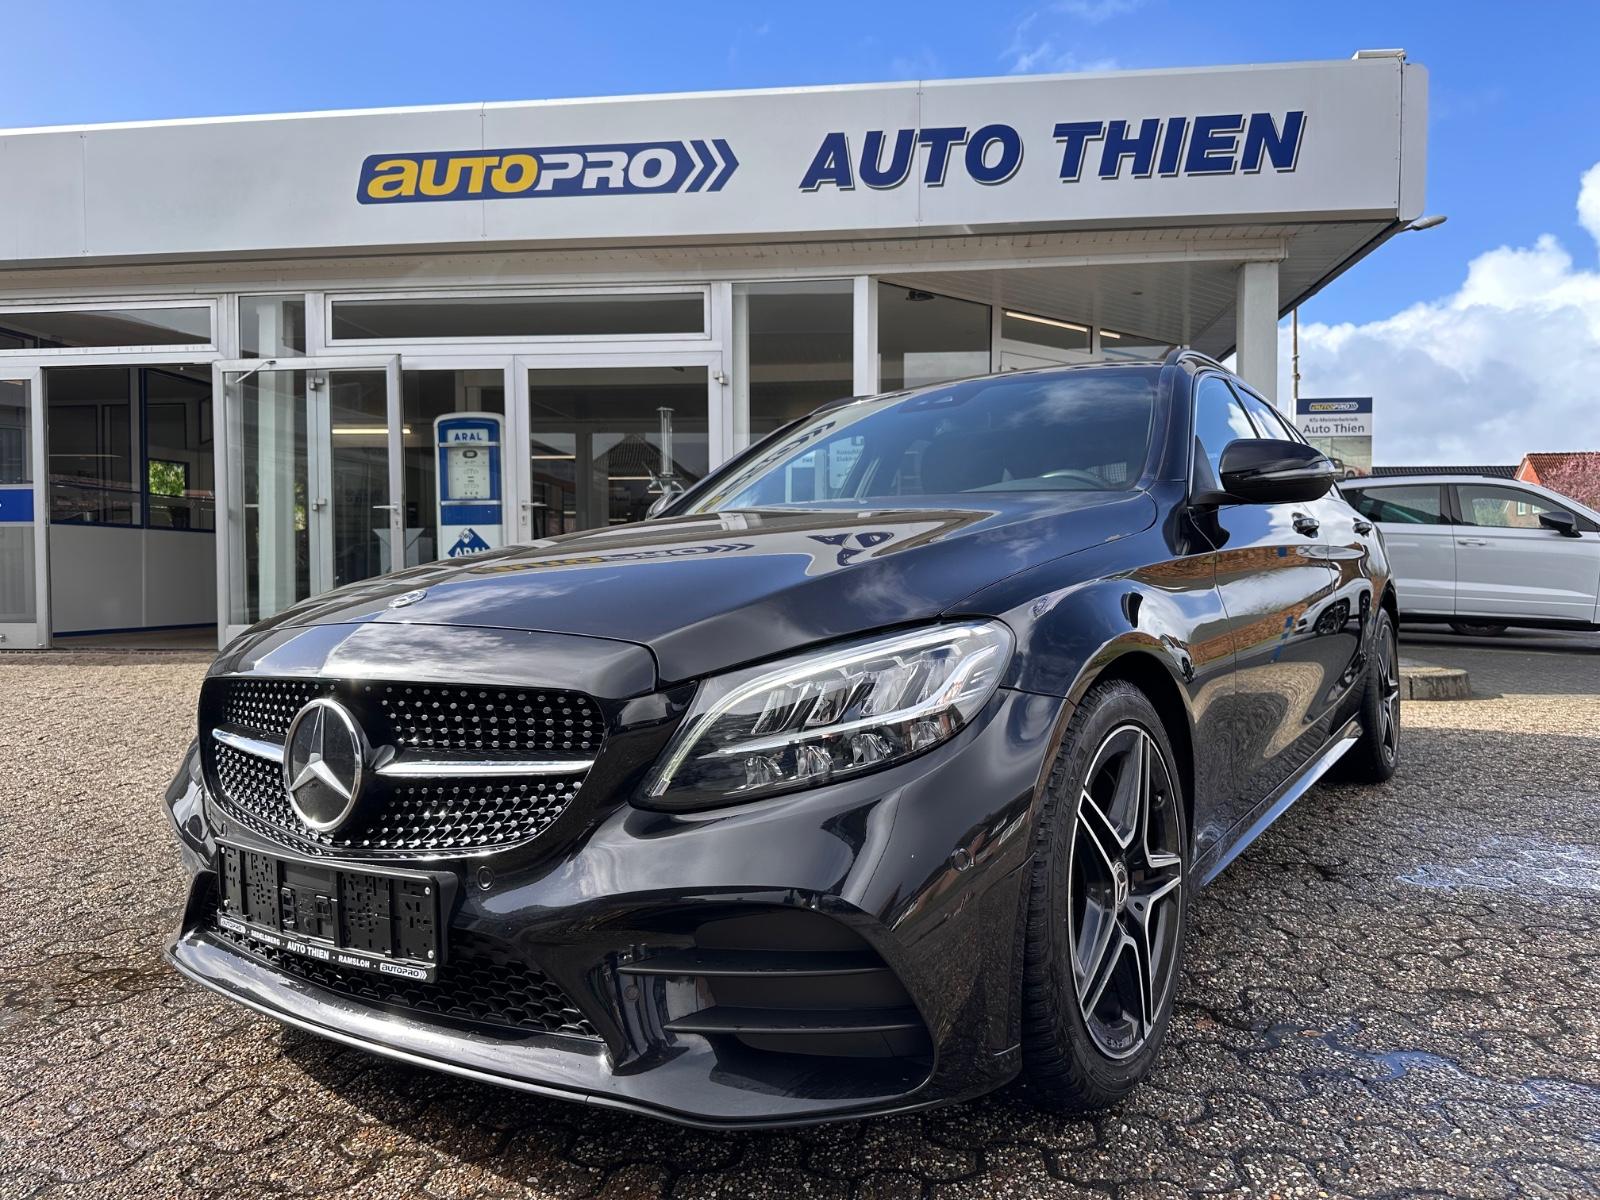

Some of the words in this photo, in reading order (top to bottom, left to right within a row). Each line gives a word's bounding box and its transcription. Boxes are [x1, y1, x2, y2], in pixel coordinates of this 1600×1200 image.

[799, 124, 1023, 193] AUTO
[1053, 111, 1307, 183] THIEN
[454, 432, 482, 440] ARAL
[1303, 424, 1331, 433] Auto
[1334, 423, 1365, 433] Thien
[287, 941, 306, 953] AUTO
[307, 946, 330, 960] THIEN
[338, 955, 370, 968] RAMSLOH
